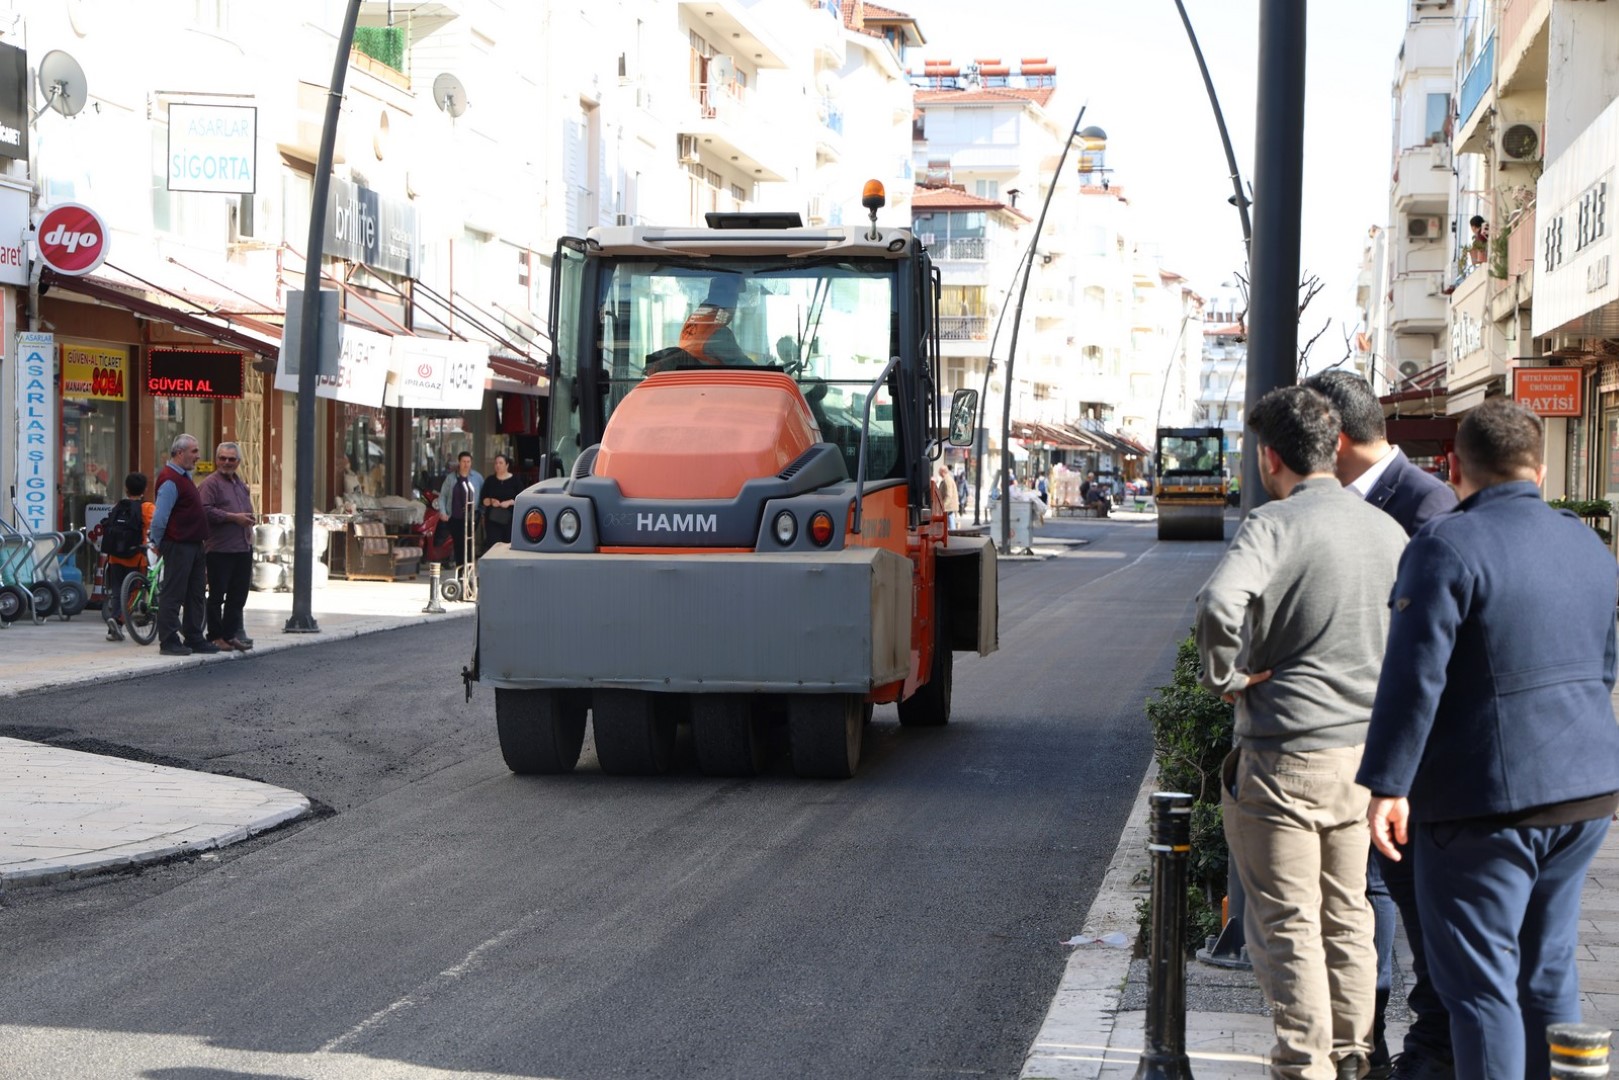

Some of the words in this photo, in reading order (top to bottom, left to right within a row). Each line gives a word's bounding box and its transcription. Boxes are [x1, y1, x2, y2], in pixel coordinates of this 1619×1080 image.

[188, 118, 249, 137] ASARLAR
[172, 148, 251, 181] SİGORTA
[44, 224, 98, 253] dyo
[98, 352, 122, 368] TİCARET
[91, 367, 124, 397] SOBA
[148, 377, 193, 391] GÜVEN
[196, 379, 213, 392] AL
[1521, 393, 1574, 410] BAYİSİ
[26, 450, 46, 533] SİGORT
[636, 512, 717, 533] HAMM
